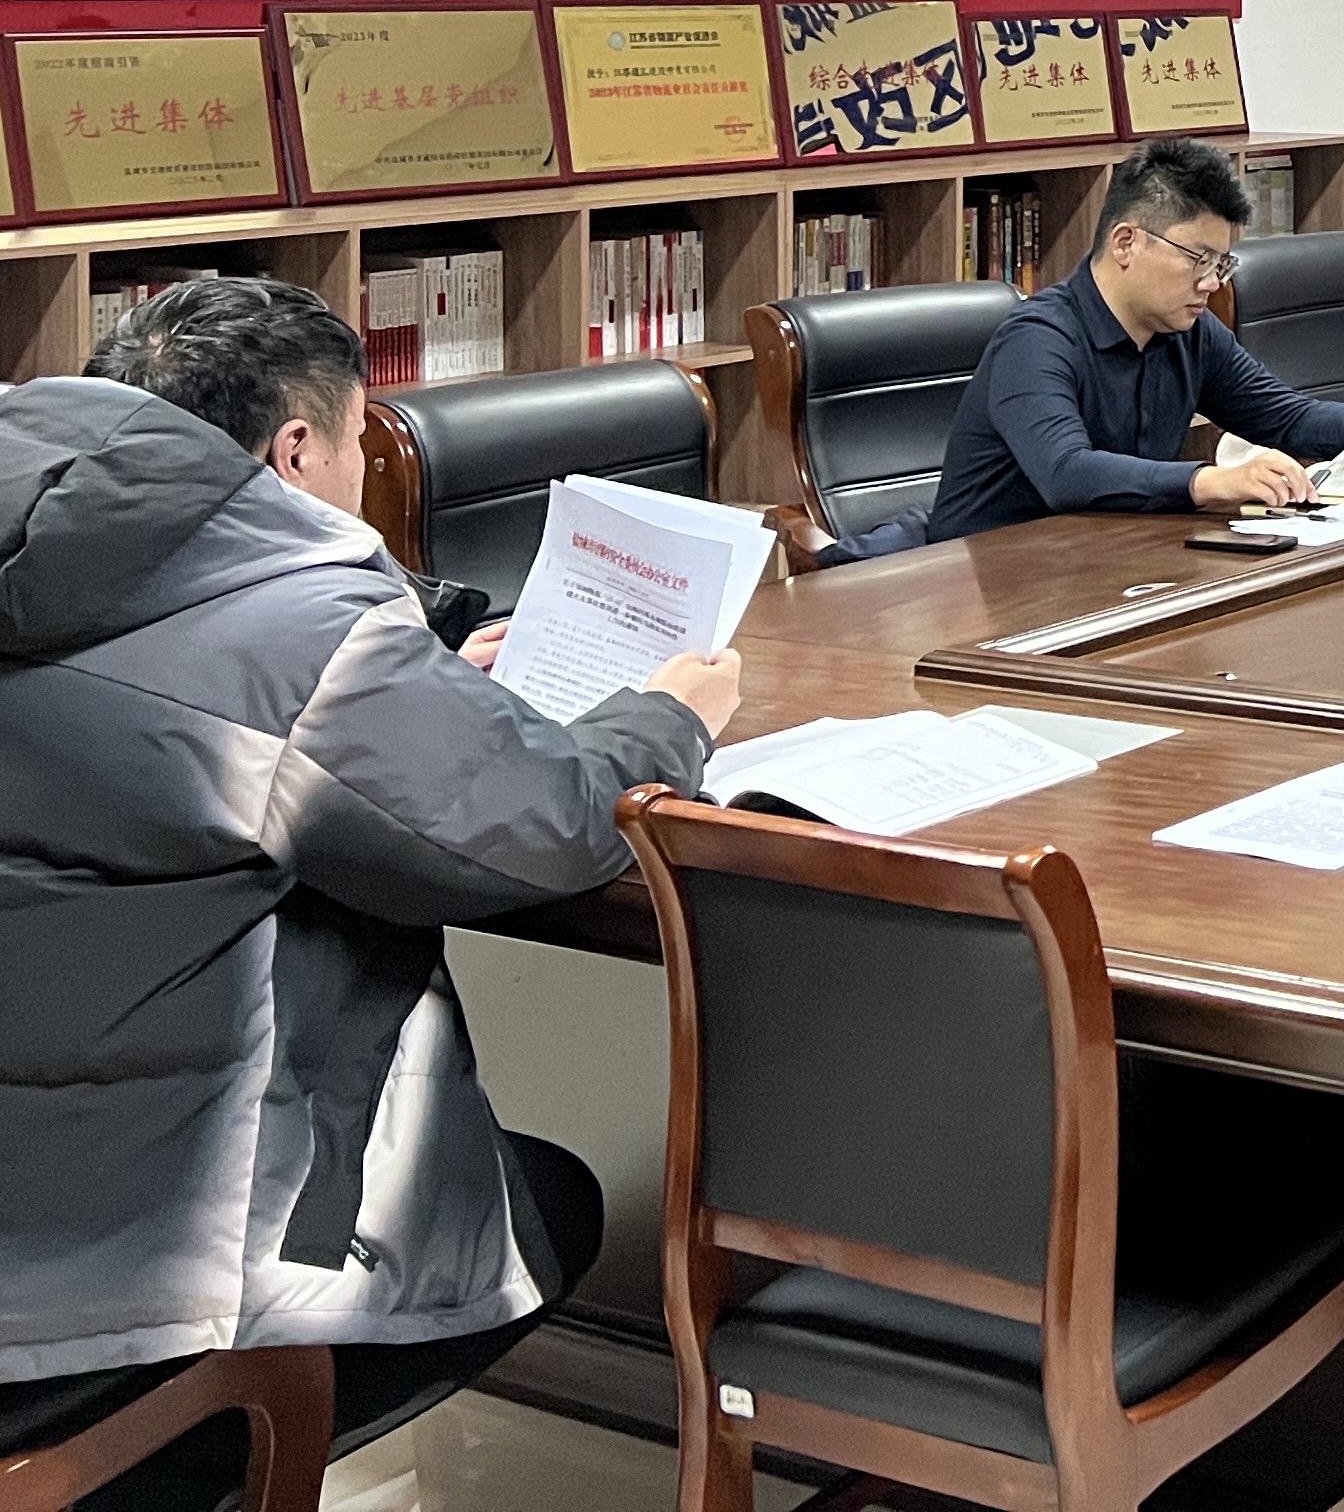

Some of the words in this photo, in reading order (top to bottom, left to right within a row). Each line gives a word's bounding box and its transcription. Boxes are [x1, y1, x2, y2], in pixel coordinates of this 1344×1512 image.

[999, 61, 1090, 91] 先进集体
[1141, 56, 1222, 85] 先进集体
[64, 97, 236, 139] 先进集体
